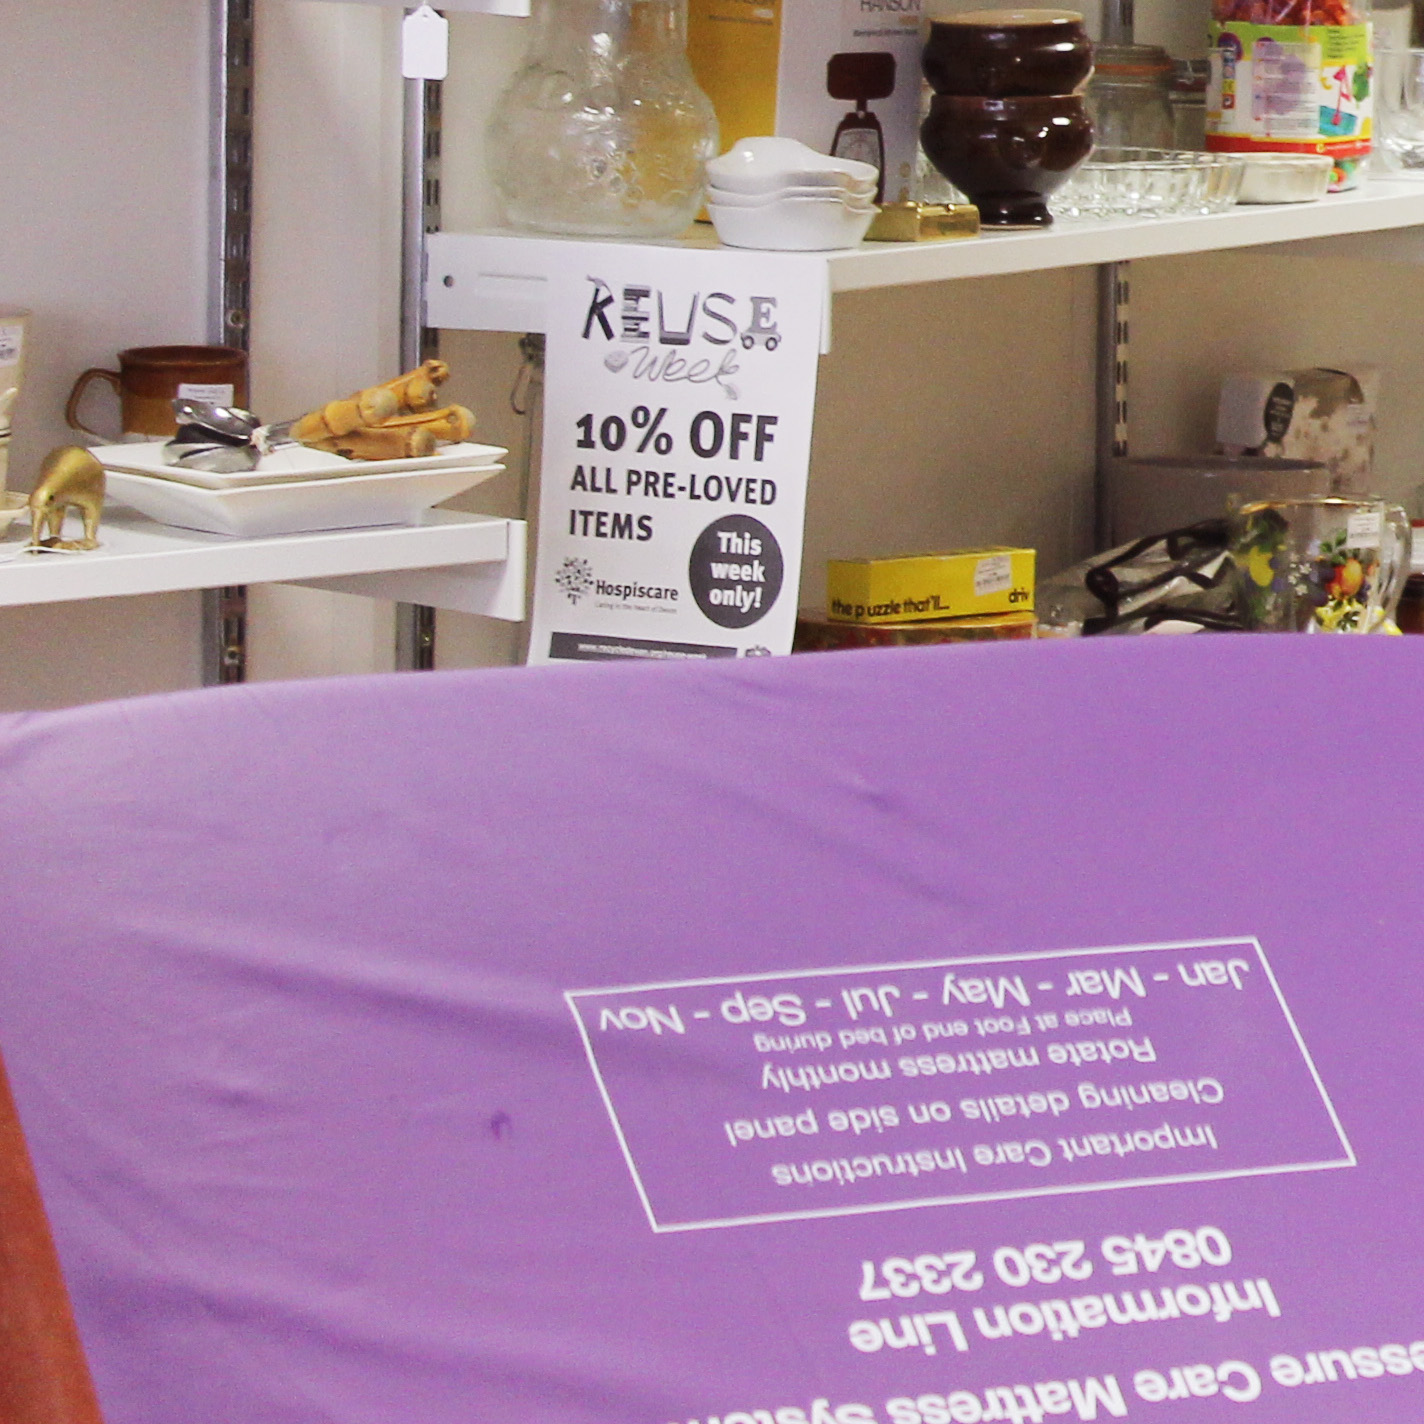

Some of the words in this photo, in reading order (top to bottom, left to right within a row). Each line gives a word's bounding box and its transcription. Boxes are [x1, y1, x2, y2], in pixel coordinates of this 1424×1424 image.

[582, 275, 782, 352] REUSE
[629, 345, 740, 396] Week
[575, 405, 673, 456] 10%
[689, 410, 779, 462] OFF
[570, 464, 618, 496] ALL
[626, 469, 777, 506] PRE-LOVED
[569, 508, 653, 542] ITEMS
[717, 531, 762, 557] This
[710, 557, 766, 583] week
[595, 579, 679, 602] Hospiscare
[709, 584, 763, 614] only!
[832, 597, 853, 617] the
[942, 972, 1031, 1008] May
[1066, 965, 1147, 1000] Mar
[1177, 958, 1250, 990] Jan
[720, 990, 807, 1026] Sep
[842, 984, 901, 1020] Jul
[1064, 1007, 1133, 1027] Place
[600, 1004, 685, 1035] Nov
[892, 1026, 917, 1046] of
[923, 1021, 969, 1043] end
[974, 1016, 1032, 1037] Foot
[1036, 1012, 1059, 1033] at
[753, 1032, 832, 1054] during
[838, 1028, 888, 1050] bed
[1046, 1036, 1157, 1067] Rotate
[762, 1059, 892, 1093] monthly
[898, 1046, 1040, 1077] mattress
[959, 1090, 1071, 1124] details
[1077, 1076, 1225, 1111] Cleaning
[724, 1107, 820, 1147] panel
[827, 1104, 900, 1135] side
[907, 1100, 951, 1125] on
[972, 1139, 1052, 1168] Care
[1057, 1122, 1219, 1162] Important
[771, 1147, 967, 1186] Instructions
[993, 1239, 1093, 1287] 230
[1100, 1225, 1233, 1276] 0845
[859, 1250, 984, 1302] 2337
[972, 1277, 1282, 1341] Information
[848, 1310, 969, 1356] Line
[1133, 1359, 1263, 1403] Care
[886, 1374, 1128, 1424] Mattress
